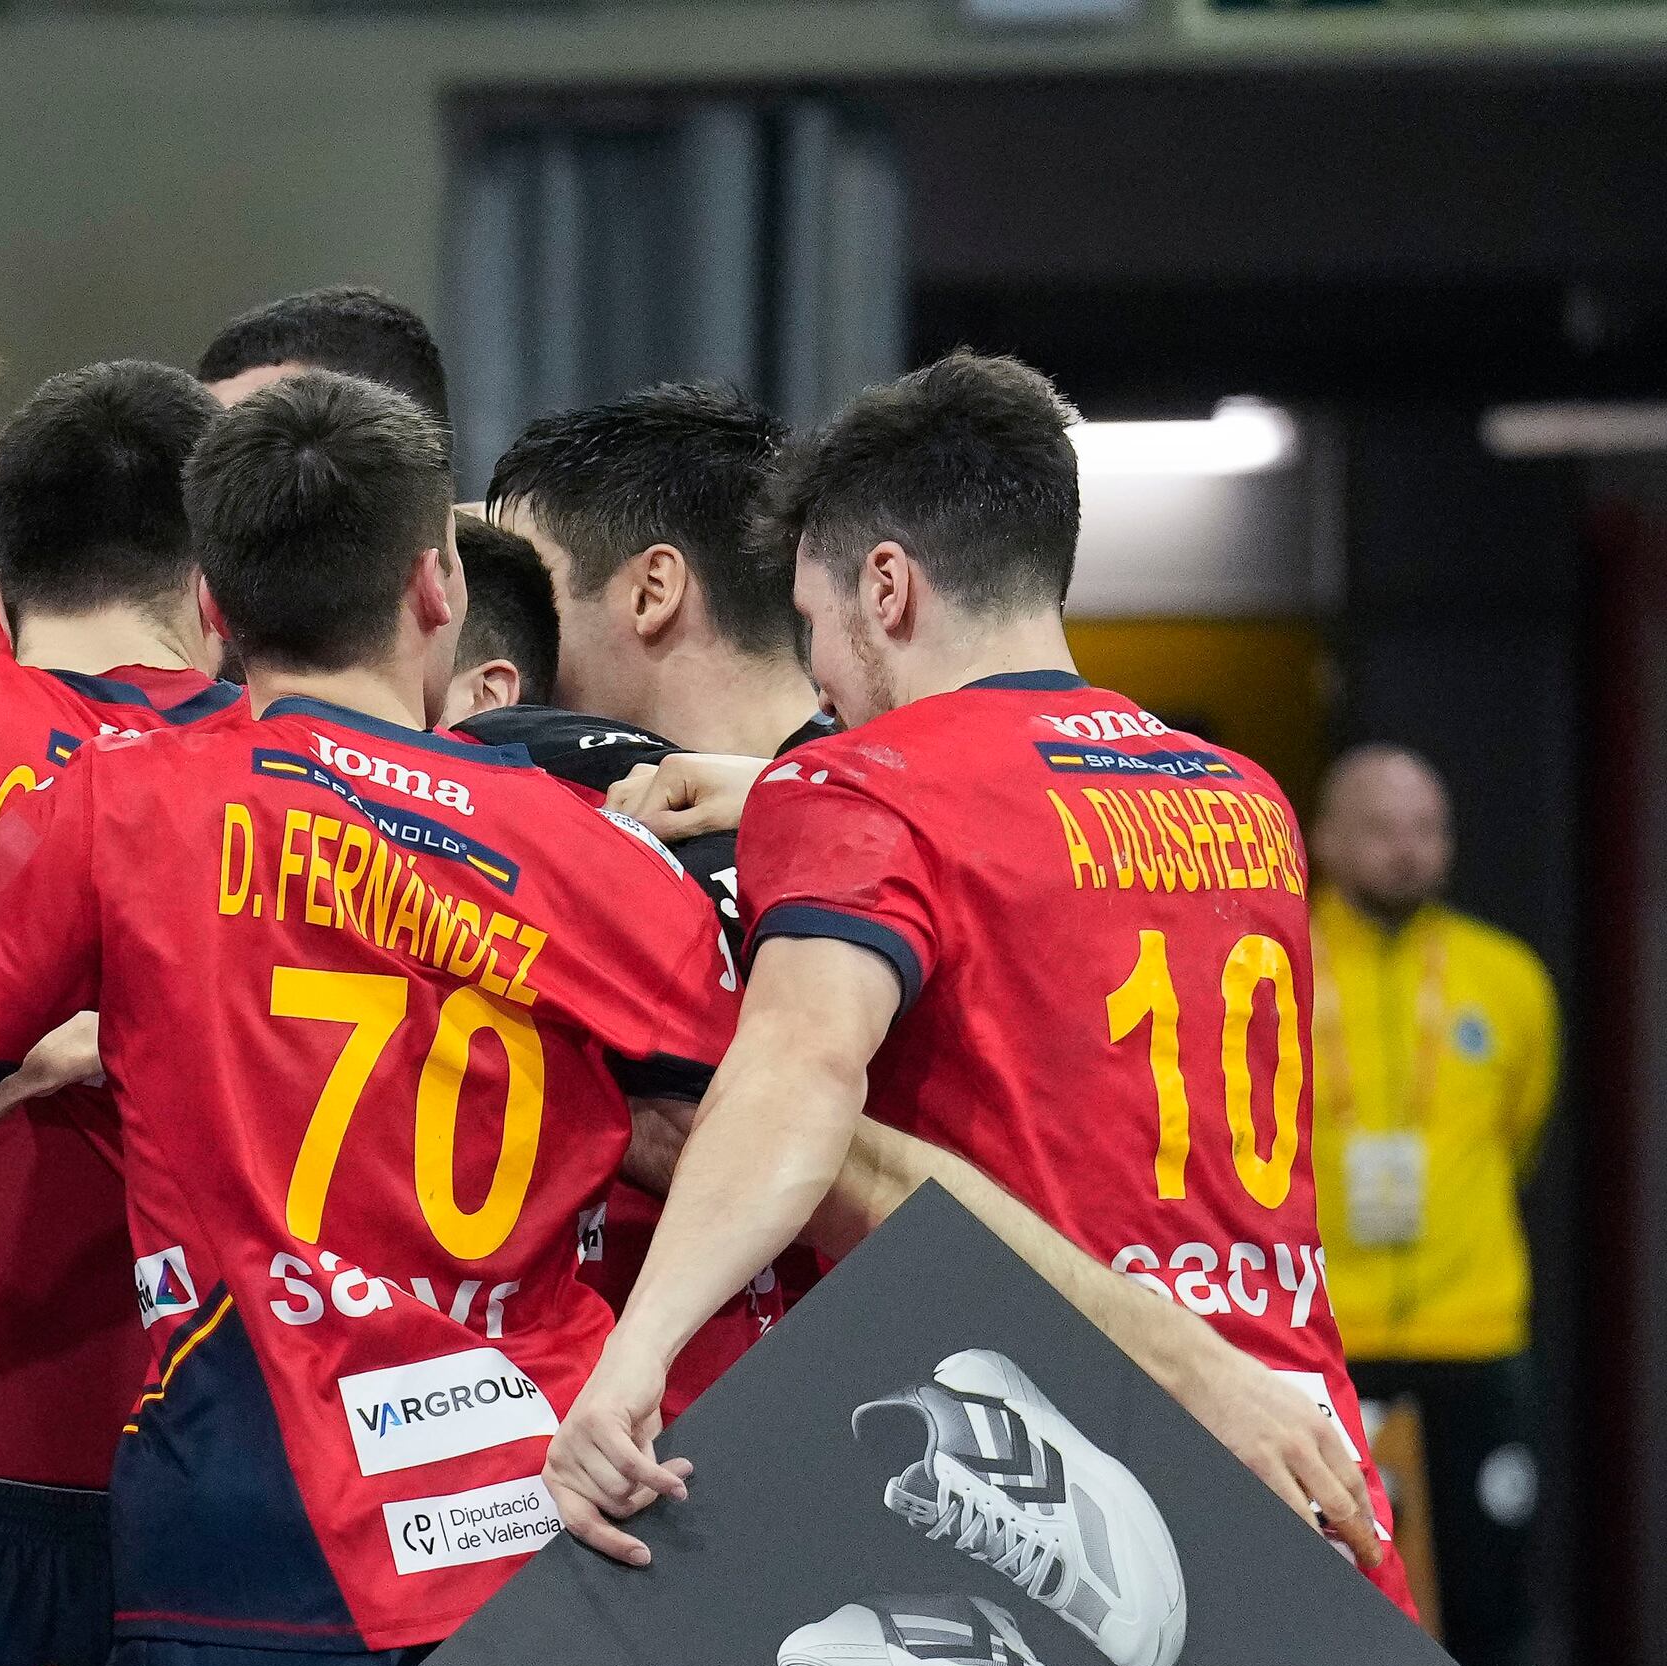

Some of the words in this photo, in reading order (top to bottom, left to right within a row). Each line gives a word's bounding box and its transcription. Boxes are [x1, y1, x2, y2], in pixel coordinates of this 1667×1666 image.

[218, 803, 262, 918] D.
[275, 809, 549, 1007] FERNÁNDEZ
[1047, 788, 1108, 891] A.
[269, 966, 545, 1260] 70
[1105, 929, 1304, 1210] 10
[450, 1491, 540, 1528] Diputació
[457, 1529, 482, 1550] de
